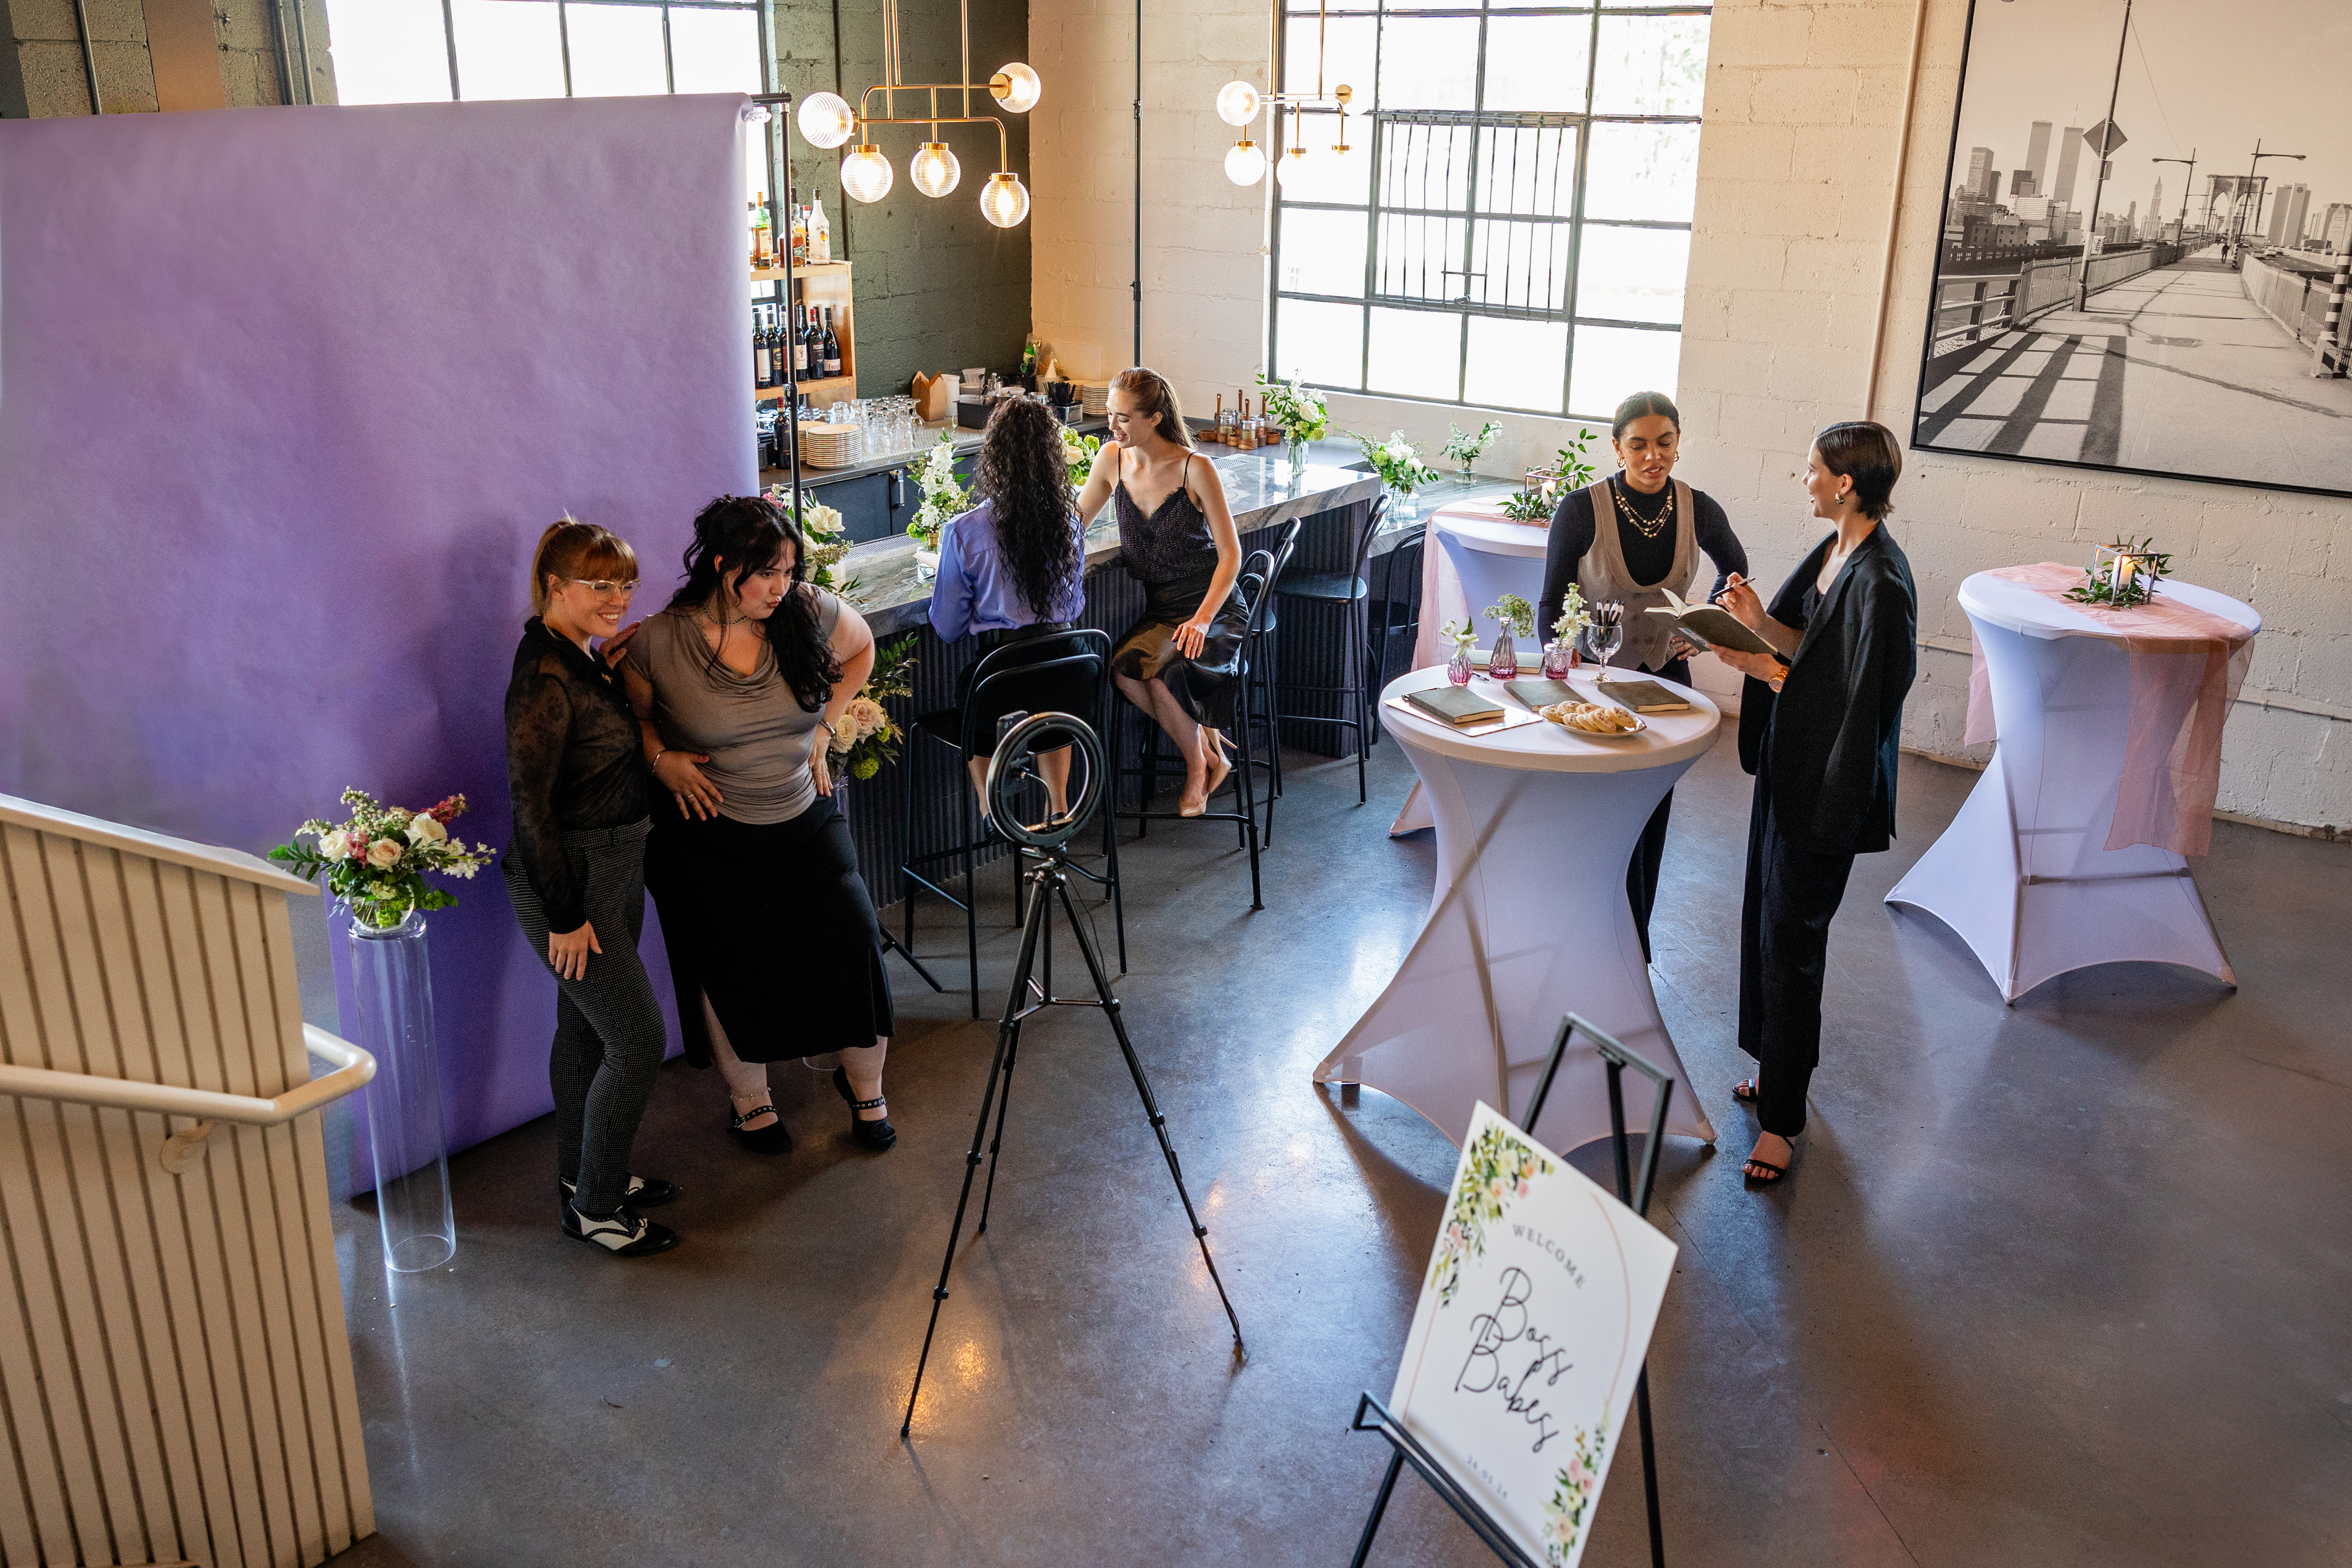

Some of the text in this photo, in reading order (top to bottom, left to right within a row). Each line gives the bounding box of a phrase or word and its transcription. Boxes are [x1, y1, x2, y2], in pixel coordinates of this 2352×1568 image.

[1512, 1223, 1586, 1289] WELCOME
[1454, 1313, 1560, 1453] Babes
[1485, 1266, 1573, 1386] Boss
